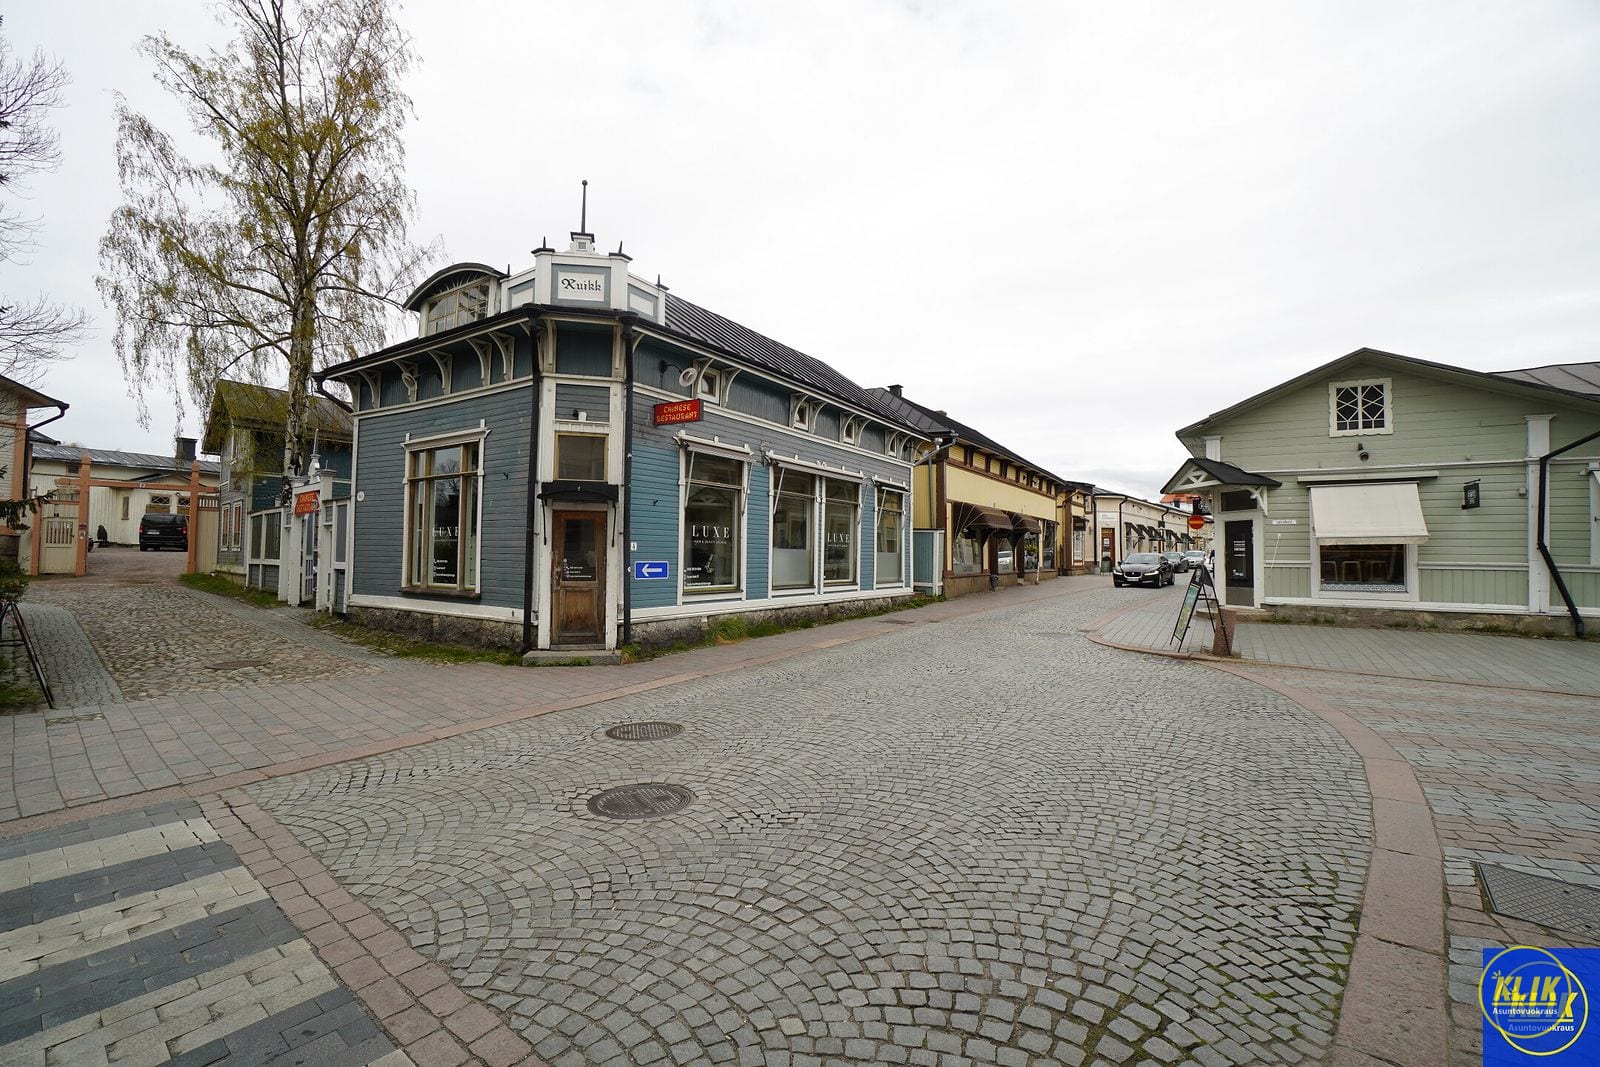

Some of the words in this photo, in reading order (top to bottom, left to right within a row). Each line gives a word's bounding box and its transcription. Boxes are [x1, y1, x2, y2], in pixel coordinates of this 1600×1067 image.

[663, 403, 692, 413] CHINESE
[656, 411, 698, 423] RESTAURANT
[692, 525, 730, 538] LUXE
[827, 533, 850, 543] LUXE
